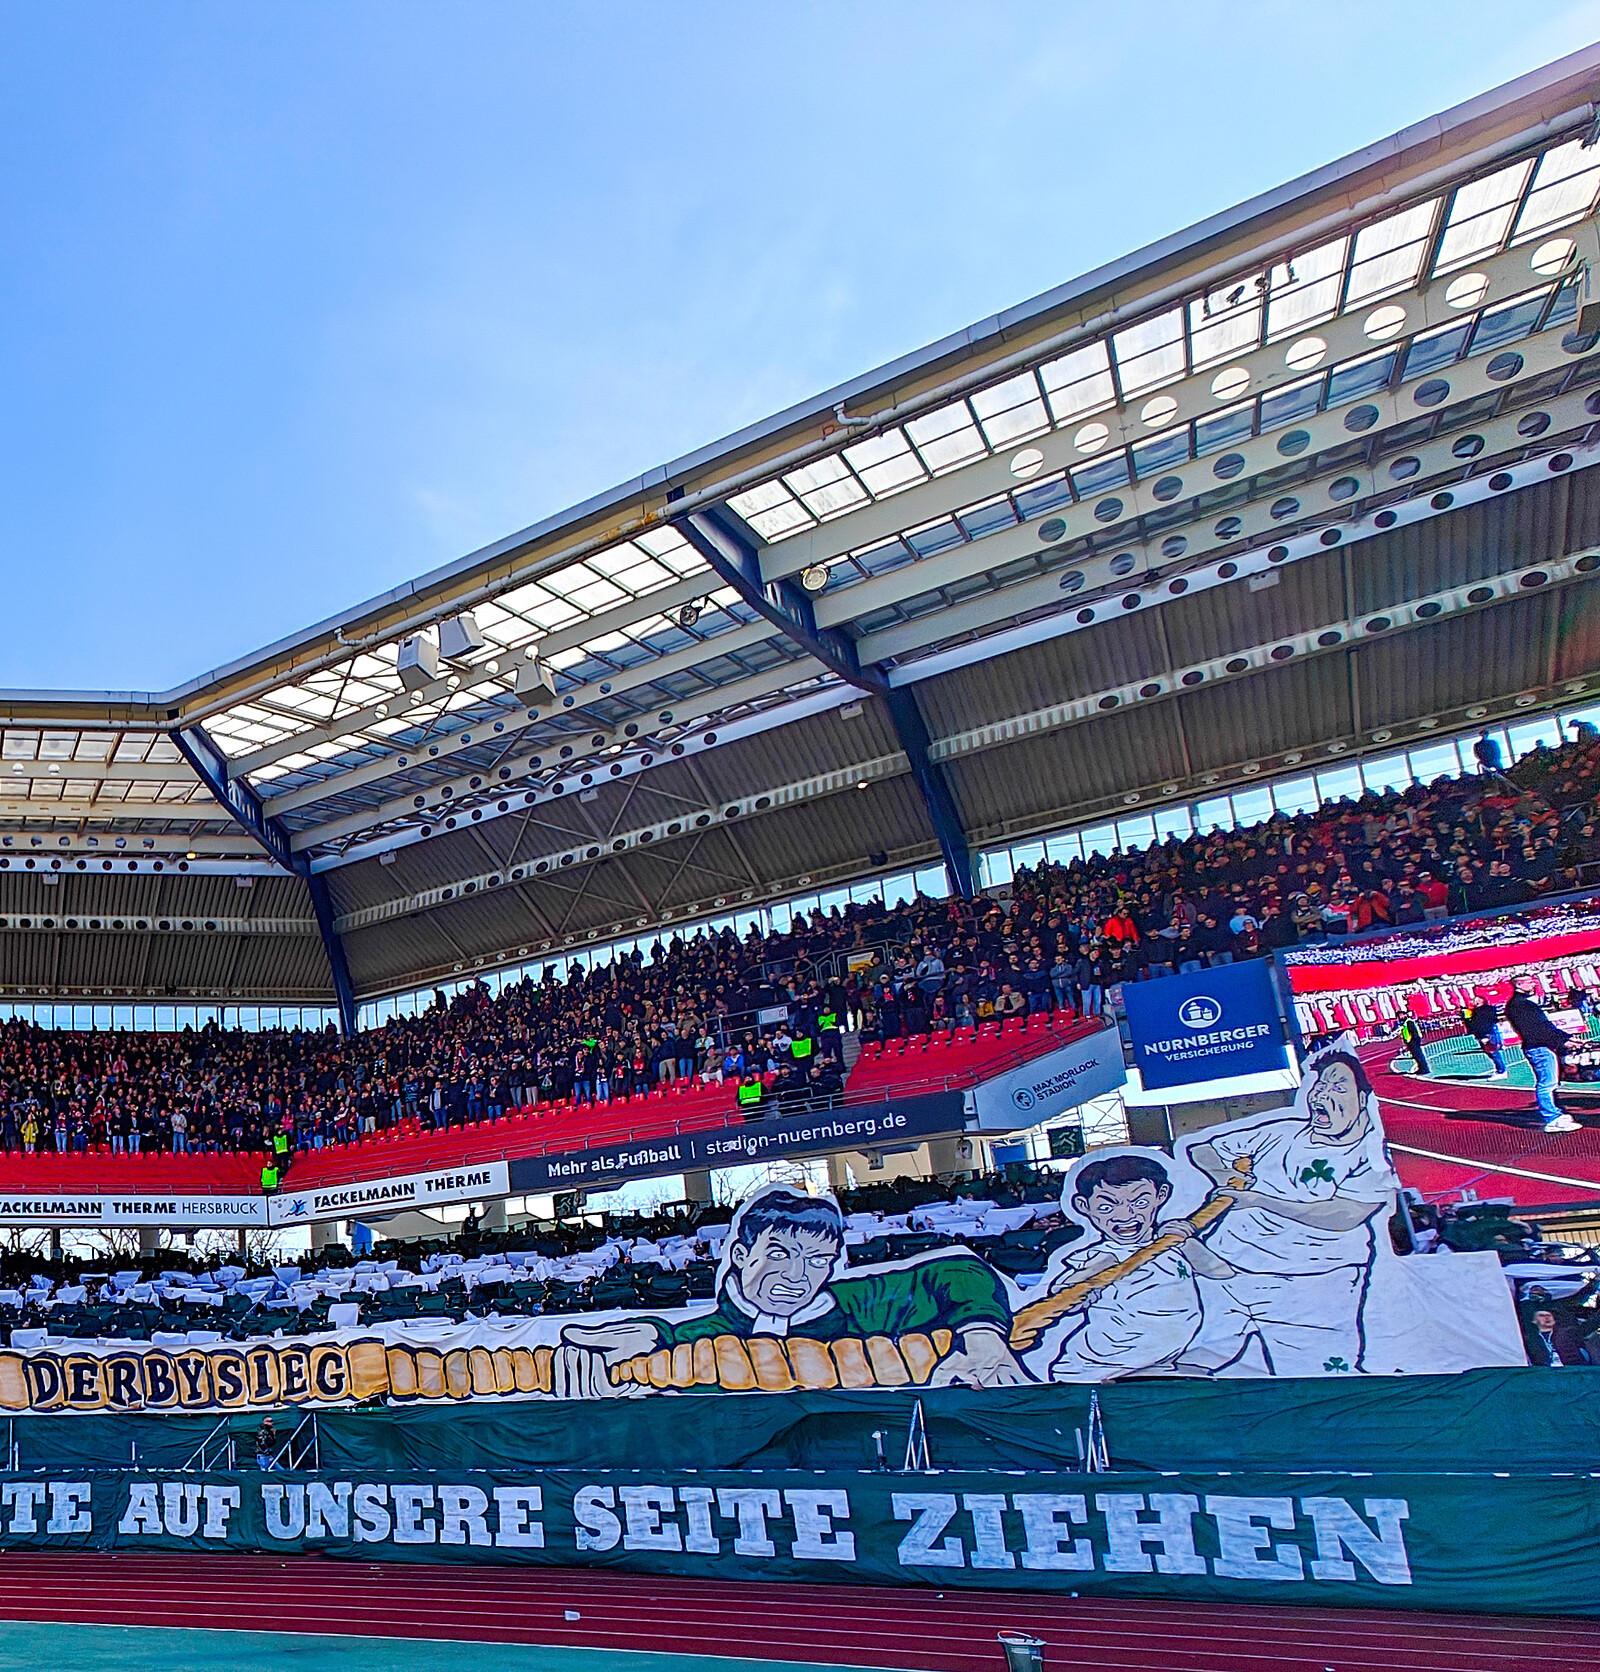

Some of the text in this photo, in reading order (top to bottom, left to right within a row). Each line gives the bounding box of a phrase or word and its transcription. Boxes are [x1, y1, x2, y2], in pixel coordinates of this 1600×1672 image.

[1421, 983, 1478, 1013] ZEIT
[1144, 1023, 1270, 1056] NÜRNBERGER
[1165, 1040, 1254, 1062] VERSICHERUNG
[1032, 1058, 1100, 1093] MAX MORLOCK
[1036, 1078, 1077, 1100] STADION
[548, 1113, 907, 1177] Mehr als Fußball stadion-nuernberg.de
[314, 1171, 491, 1209] FACKELMANN THERME
[113, 1202, 176, 1214] THERME
[182, 1202, 258, 1214] HERSBRUCK
[32, 1352, 346, 1403] DERBYSIEG
[118, 1481, 241, 1537] AUF
[261, 1481, 545, 1549] UNSERE
[572, 1484, 856, 1561] SEITE
[891, 1492, 1413, 1585] ZIEHEN
